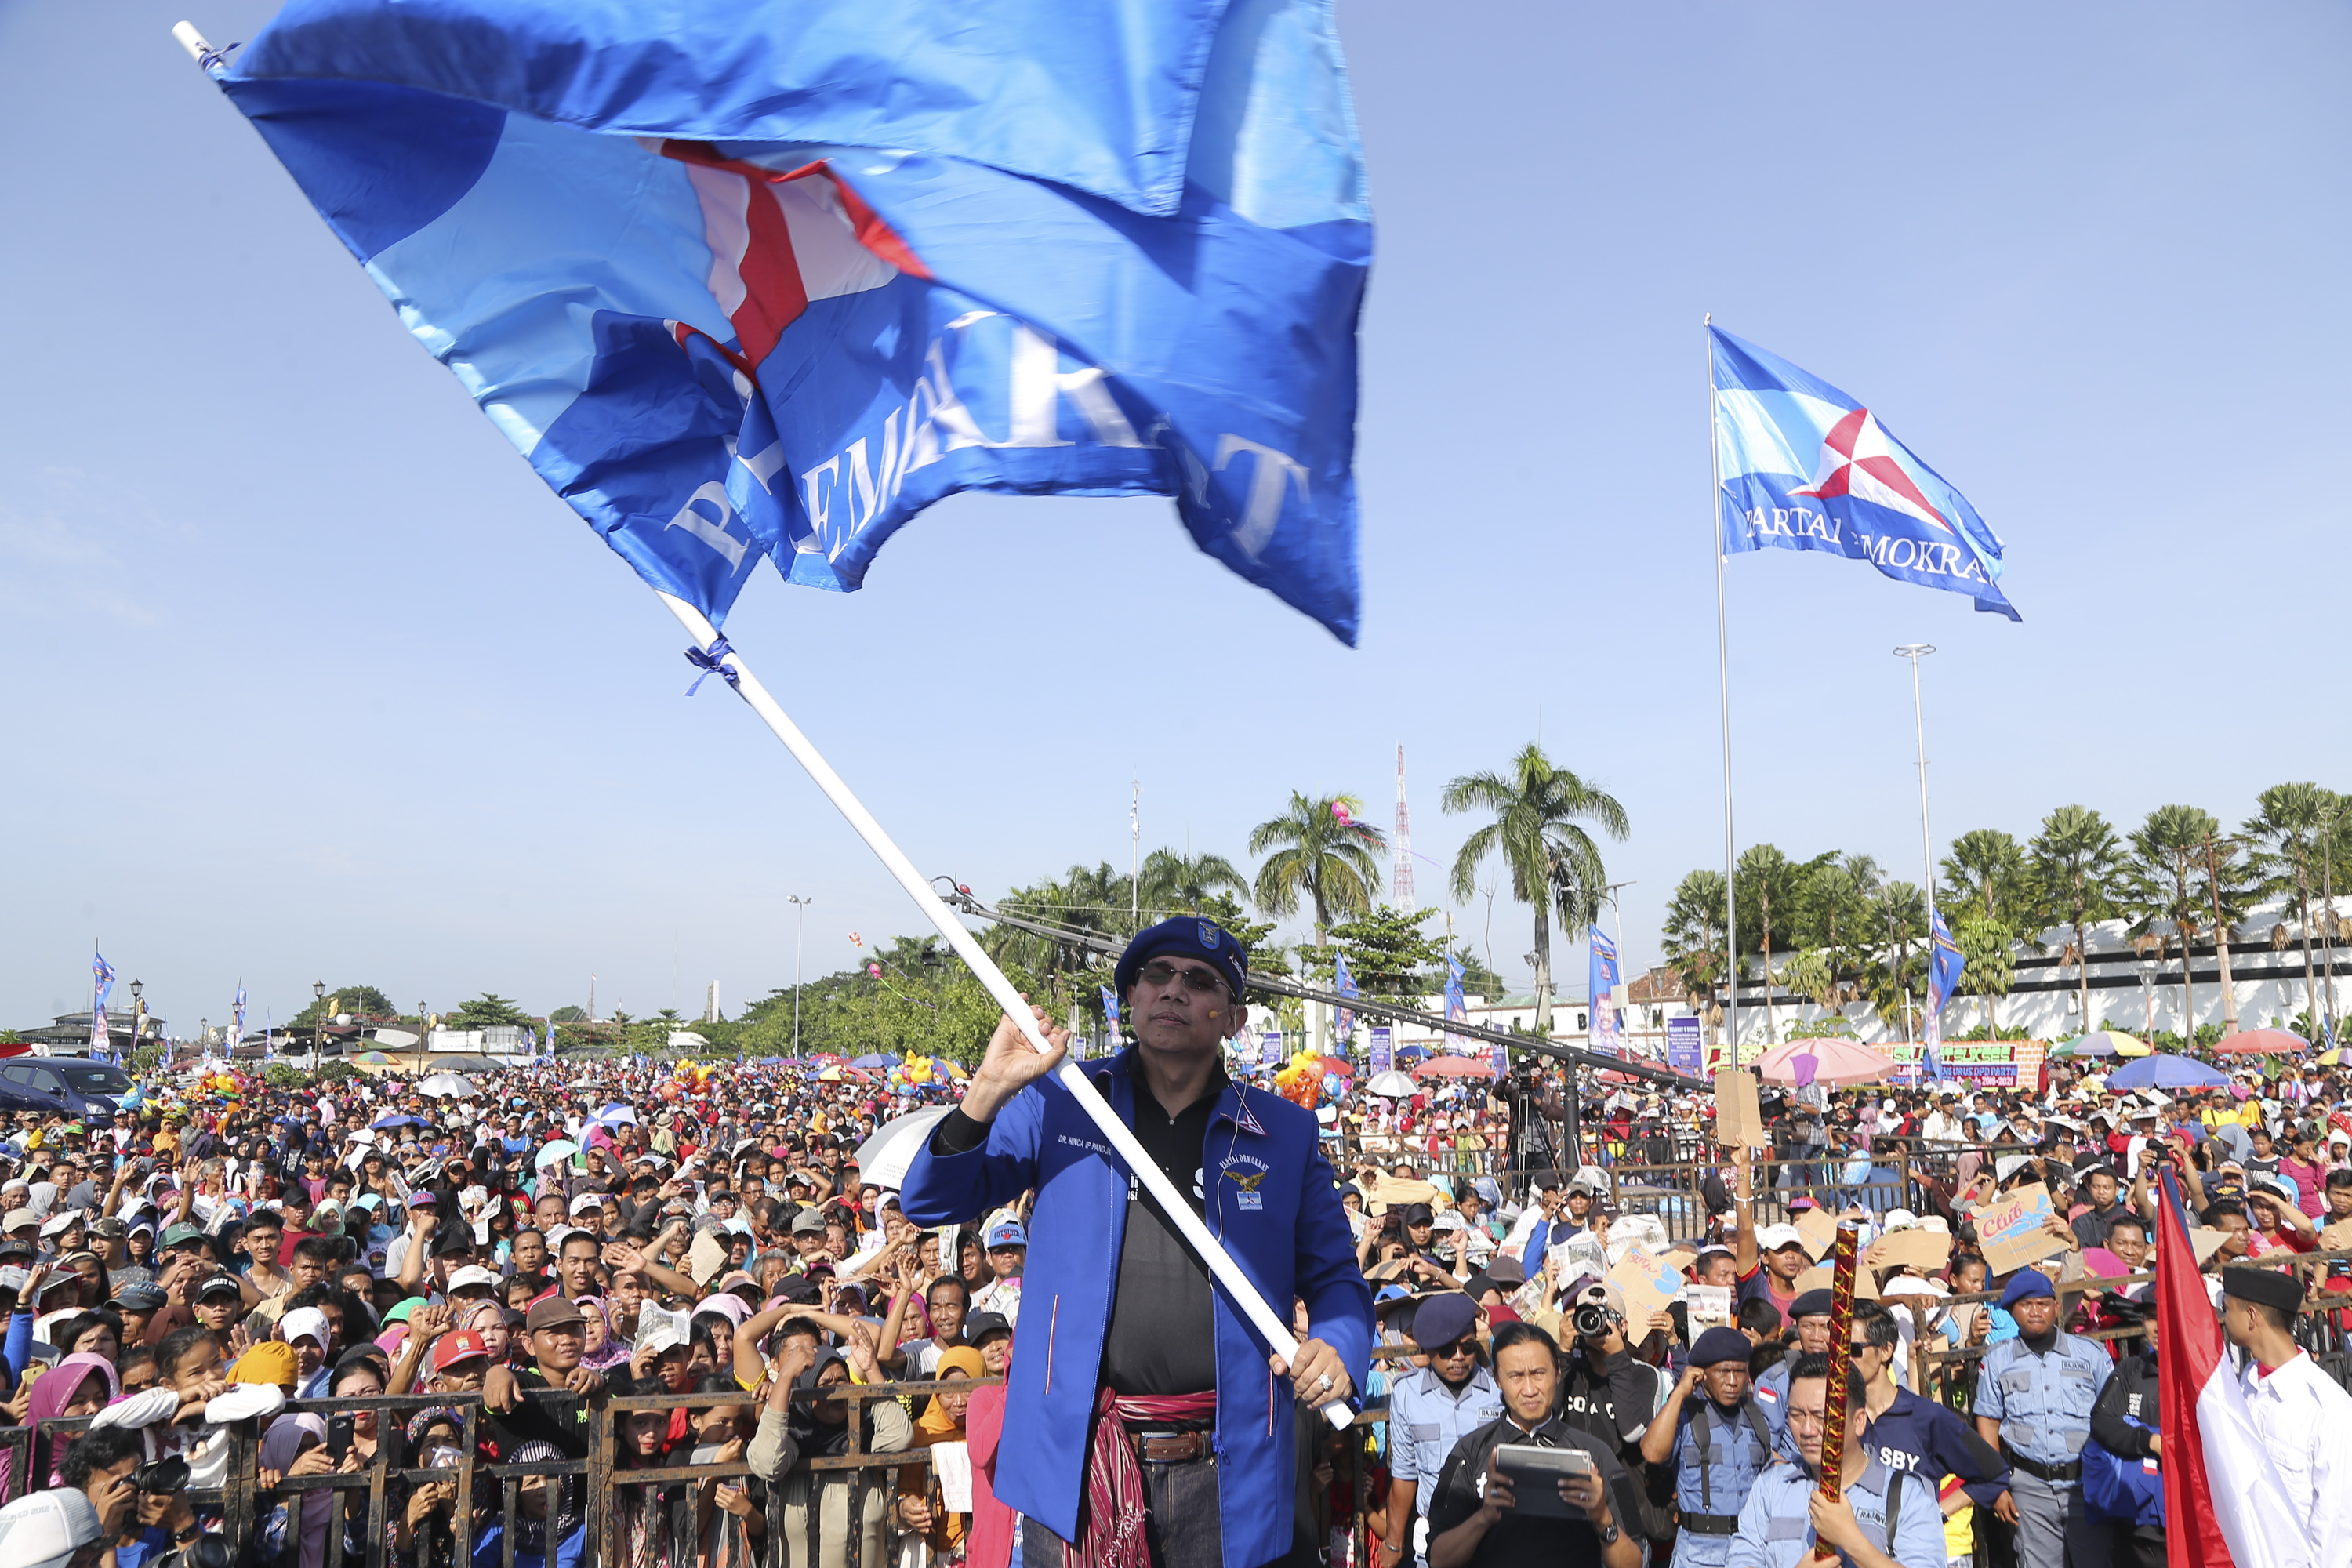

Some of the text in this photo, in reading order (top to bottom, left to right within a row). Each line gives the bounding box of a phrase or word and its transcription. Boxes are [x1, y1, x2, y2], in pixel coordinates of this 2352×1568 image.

[1851, 531, 2001, 587] MOKRA
[1954, 1047, 2011, 1062] SUKSES
[1973, 1066, 1991, 1077] DPD
[1068, 1136, 1084, 1149] HINCA
[1239, 1153, 1269, 1173] DEMOKRAT
[1982, 1201, 2023, 1238] Club
[201, 1277, 228, 1291] TELOLET
[1481, 1409, 1501, 1418] RAJAW
[1879, 1446, 1920, 1472] SBY
[1860, 1510, 1886, 1526] RAJAW
